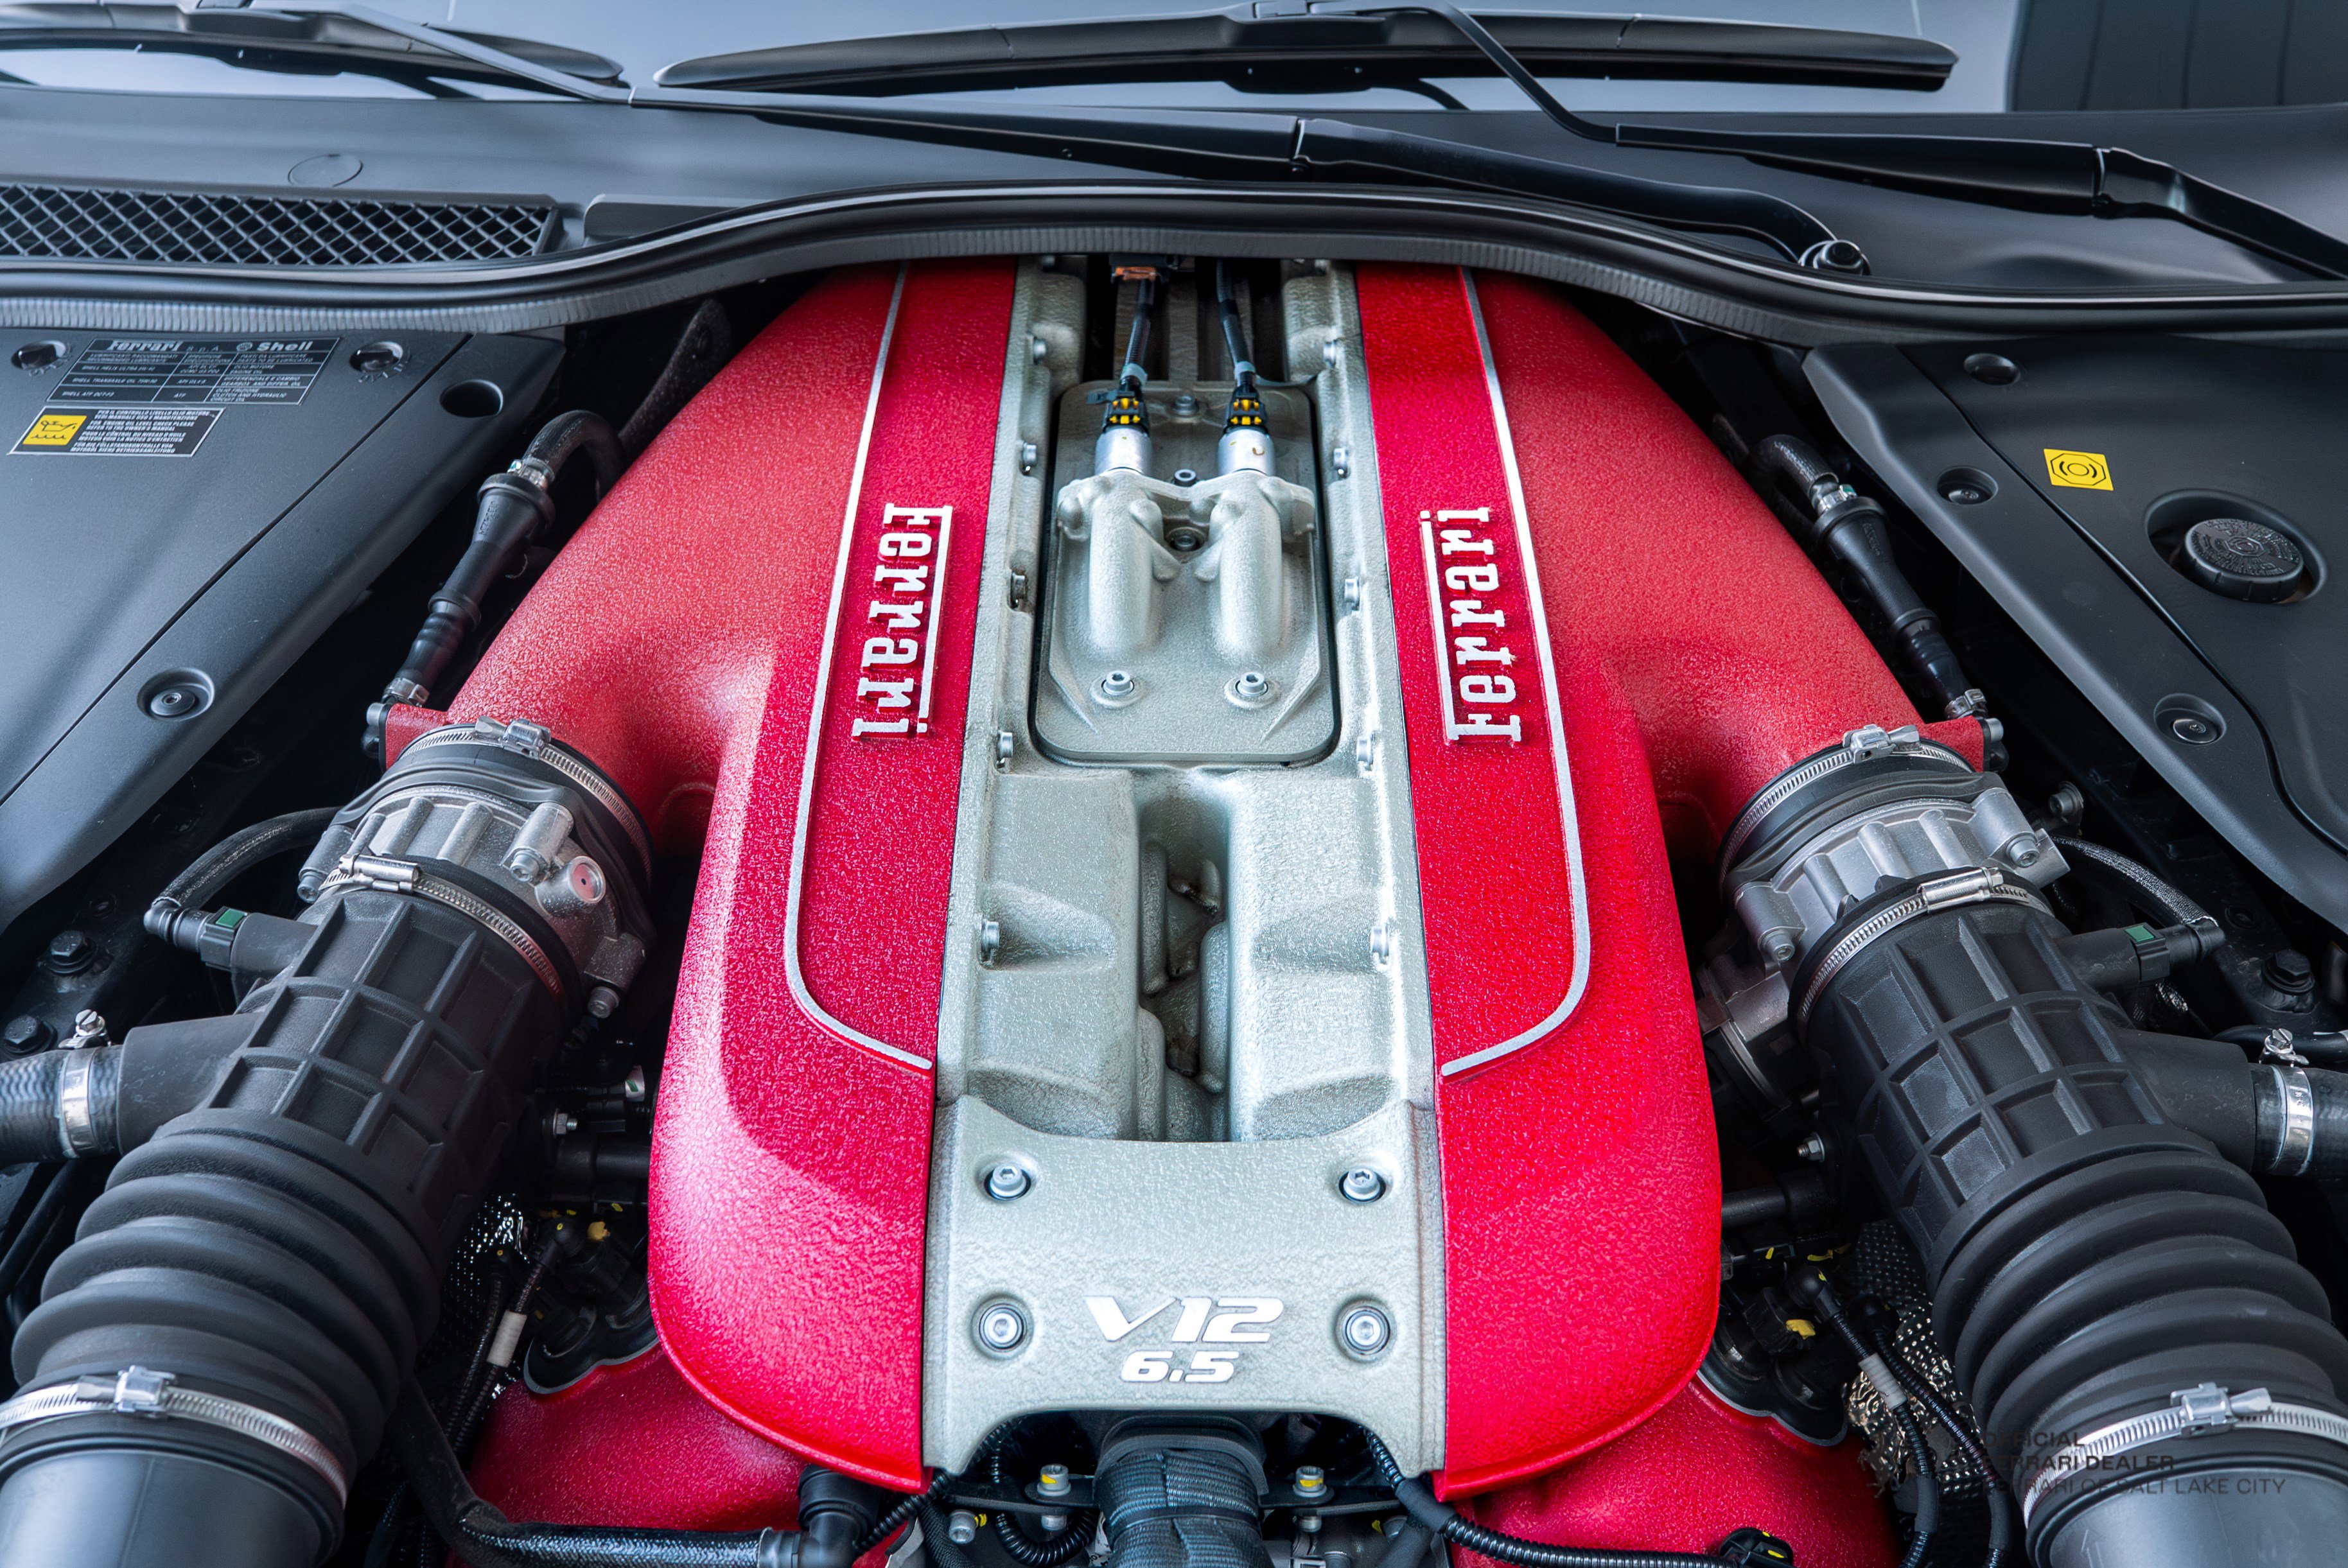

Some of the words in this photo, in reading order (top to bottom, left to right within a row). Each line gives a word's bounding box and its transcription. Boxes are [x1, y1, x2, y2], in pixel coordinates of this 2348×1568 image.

[107, 340, 184, 352] Ferrari
[257, 341, 313, 351] Shell
[851, 502, 953, 741] Ferrari
[1419, 507, 1522, 744] Ferrari
[1084, 1296, 1284, 1342] V12
[1120, 1350, 1240, 1383] 6.5
